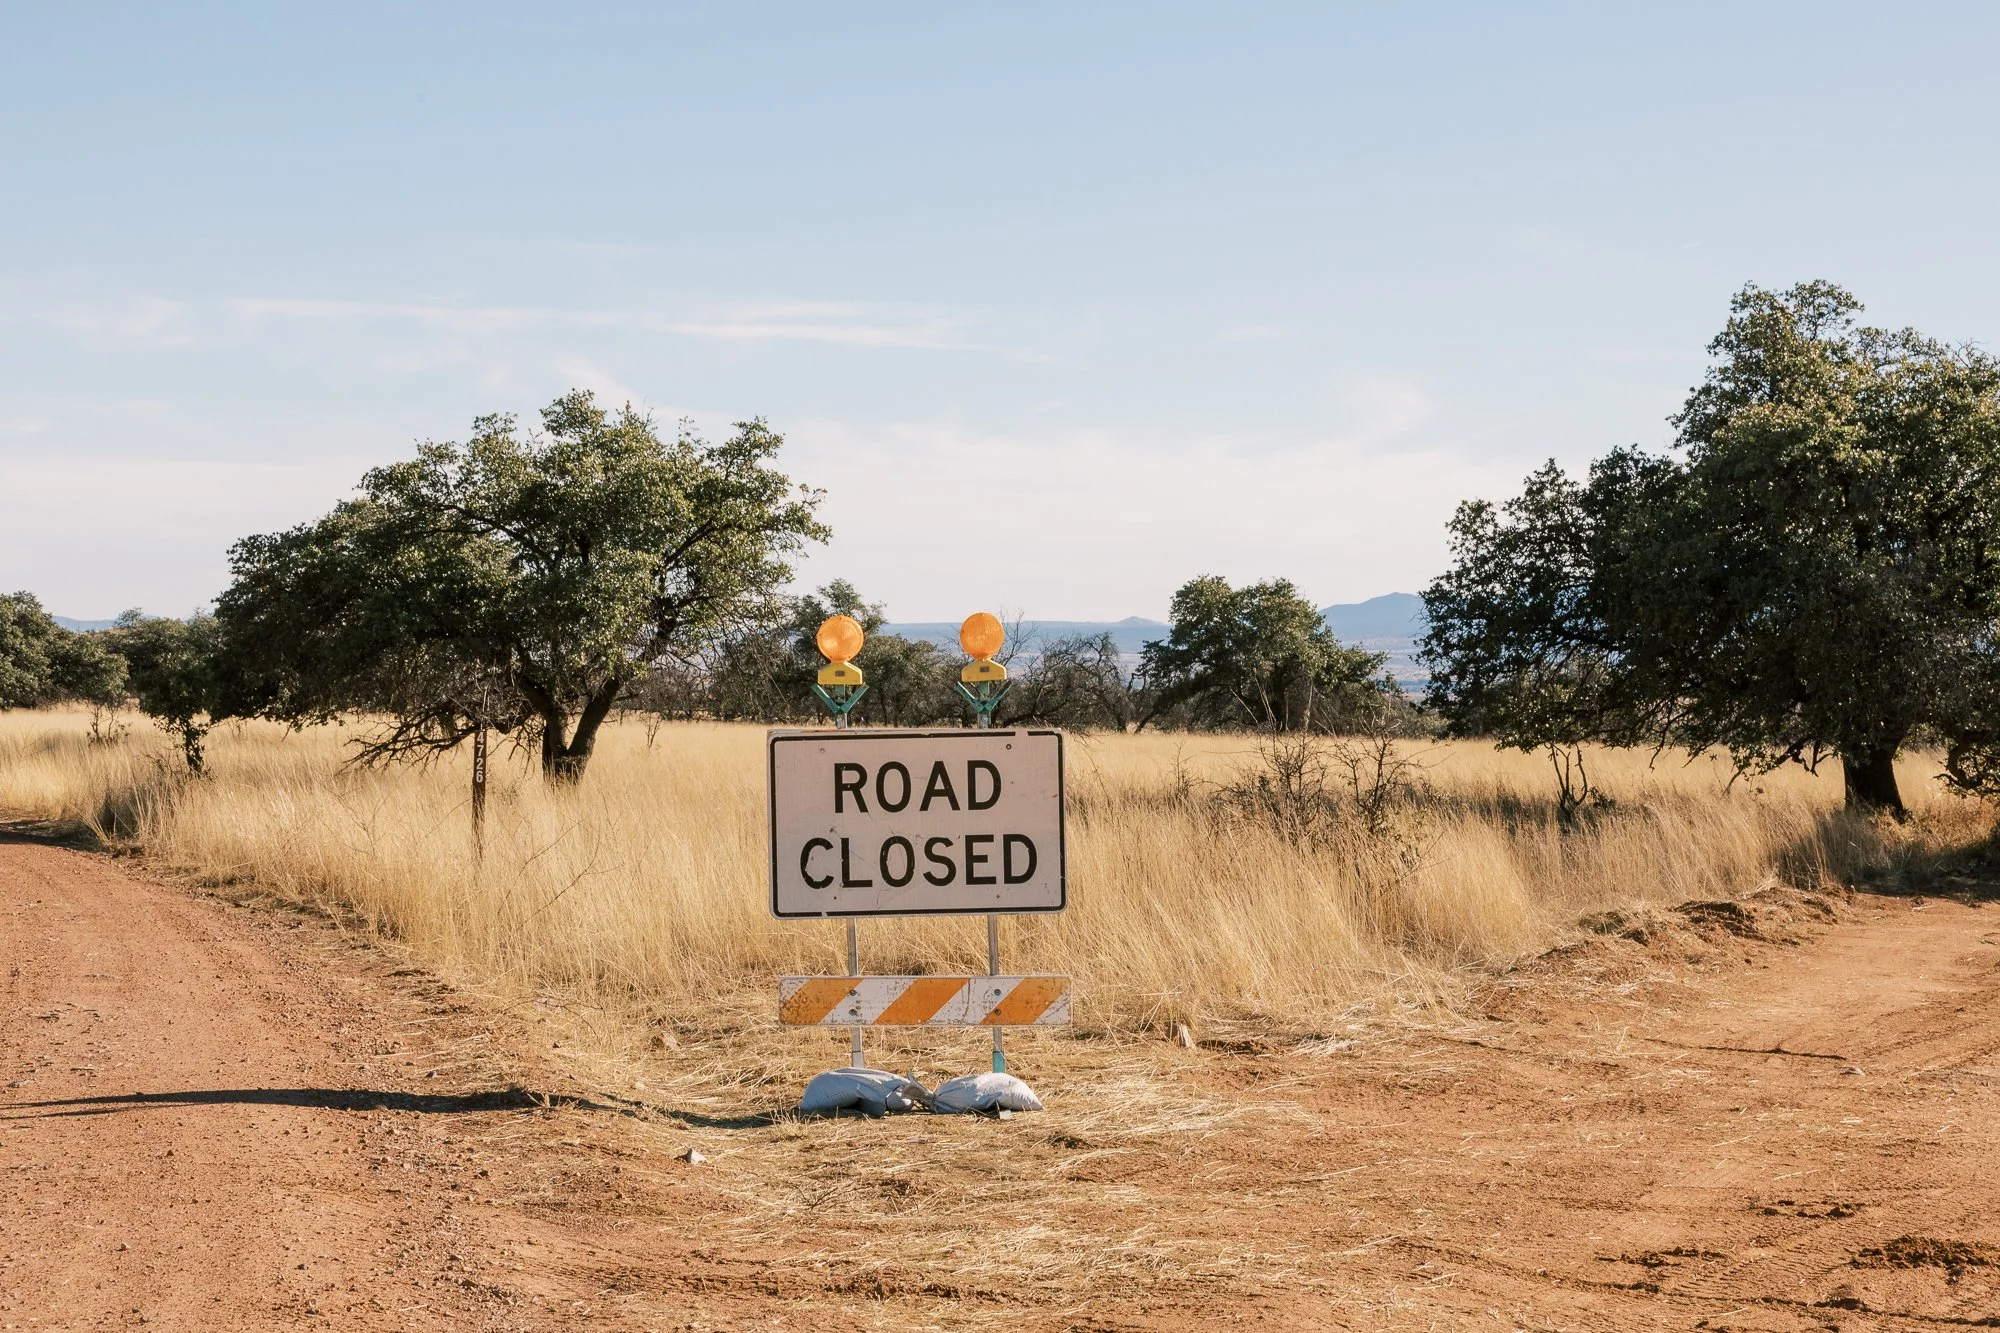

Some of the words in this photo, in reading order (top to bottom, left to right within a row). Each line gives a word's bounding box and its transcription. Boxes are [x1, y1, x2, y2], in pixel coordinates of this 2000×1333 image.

[476, 731, 485, 783] 4726
[833, 759, 1002, 813] ROAD
[800, 833, 1038, 889] CLOSED
